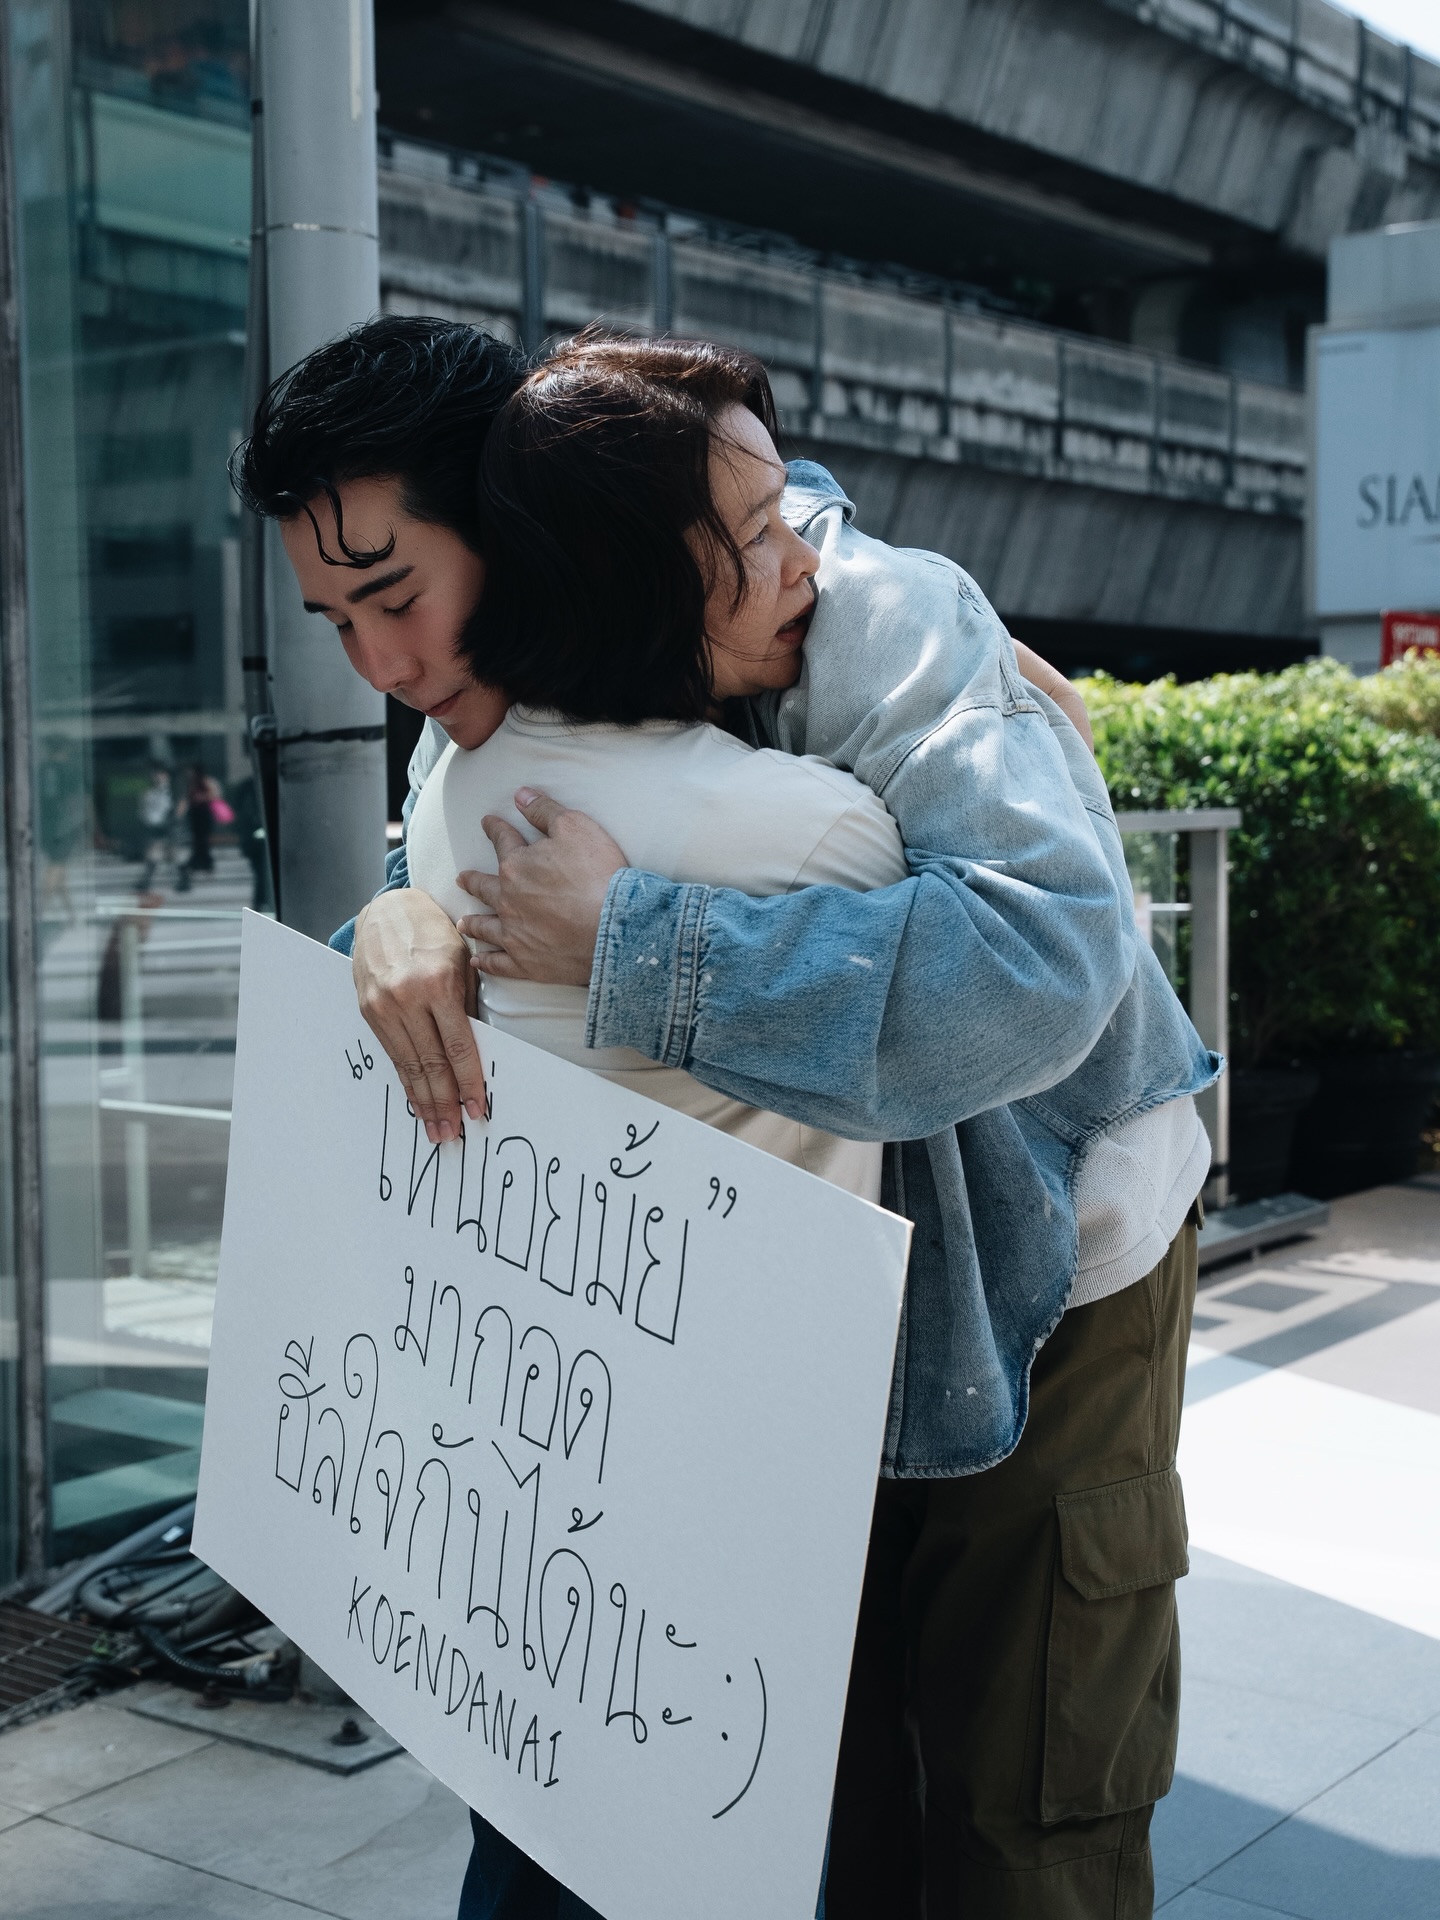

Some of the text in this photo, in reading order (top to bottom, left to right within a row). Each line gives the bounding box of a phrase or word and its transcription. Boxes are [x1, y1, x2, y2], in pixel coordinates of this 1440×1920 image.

[1356, 473, 1440, 530] SIA
[394, 1265, 612, 1485] มากอด
[346, 1575, 563, 1789] KOENDANAI
